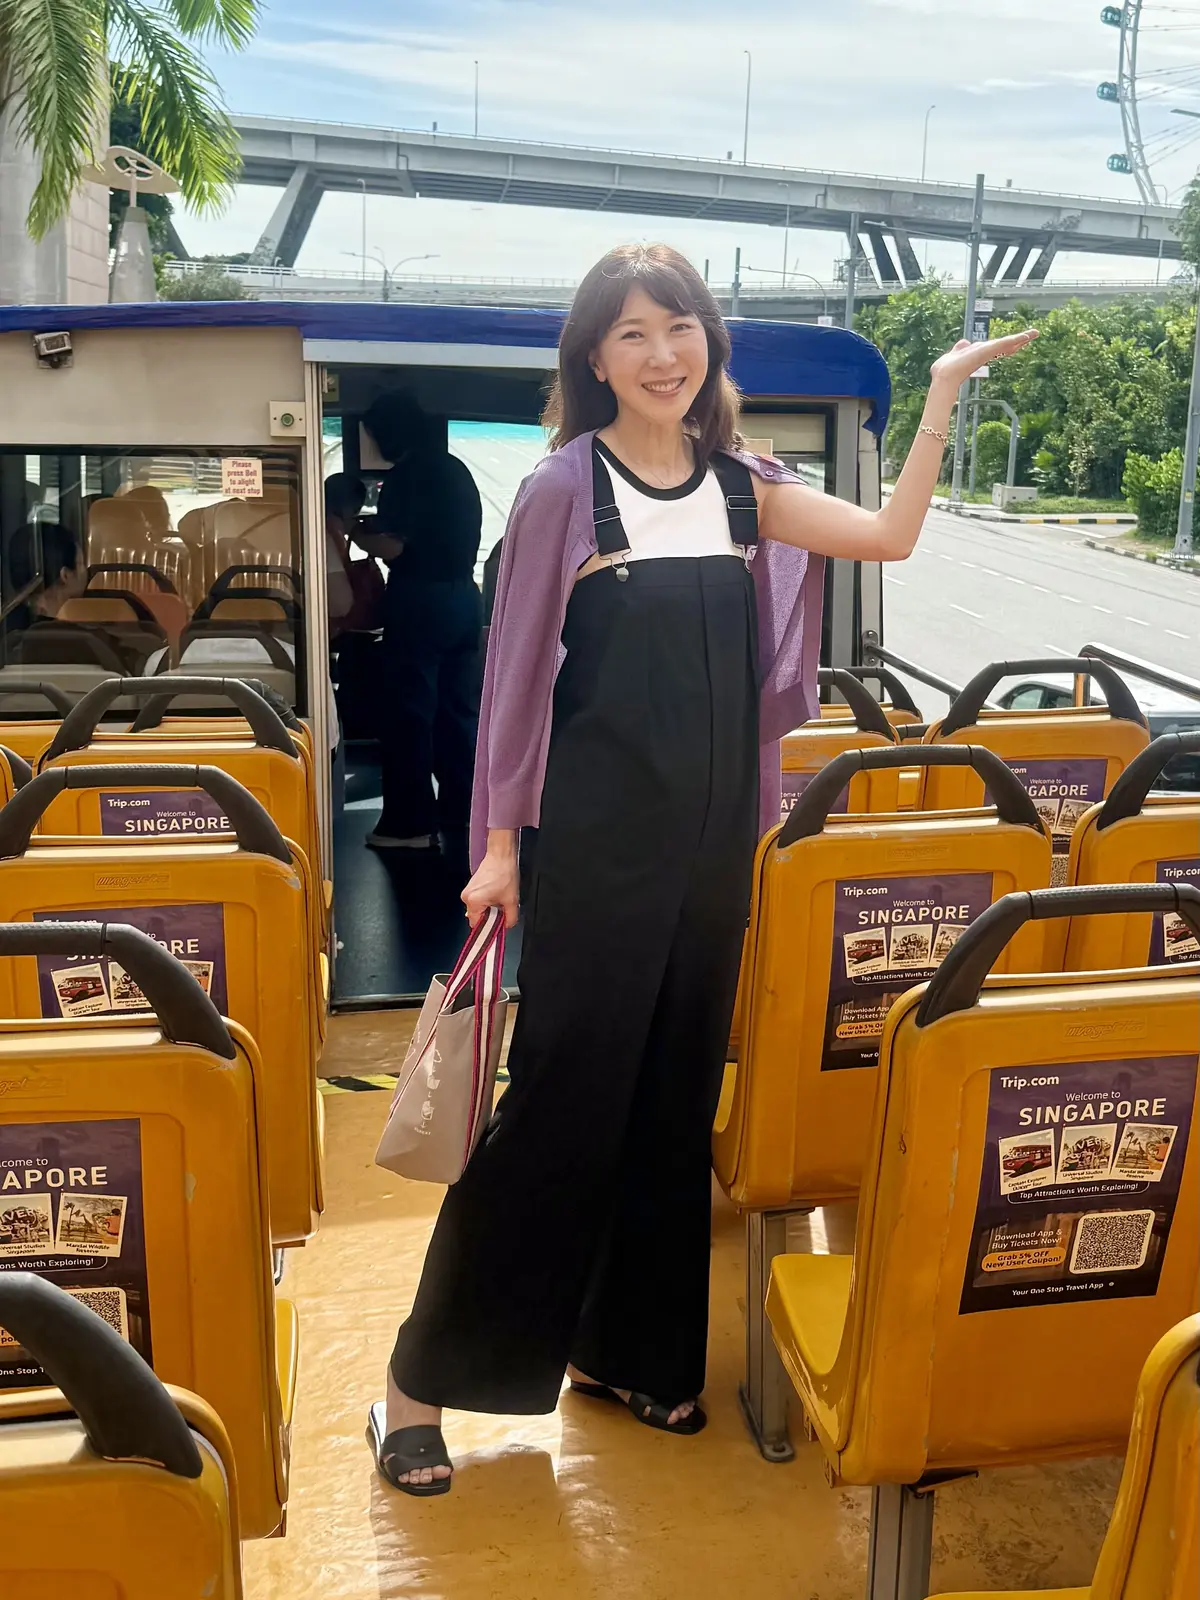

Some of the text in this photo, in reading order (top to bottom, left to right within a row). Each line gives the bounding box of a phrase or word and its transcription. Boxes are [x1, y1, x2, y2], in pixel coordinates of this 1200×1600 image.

[231, 460, 252, 468] Please
[238, 478, 255, 486] alight
[1024, 785, 1088, 796] GAPORE
[108, 799, 150, 808] Trip.com
[125, 816, 230, 832] SINGAPORE
[843, 886, 888, 897] Trip.com
[858, 905, 970, 924] SINGAPORE
[1000, 1076, 1060, 1090] Trip.com
[1066, 1091, 1121, 1102] Welcome to
[1019, 1098, 1166, 1126] SINGAPORE
[36, 1158, 48, 1166] to
[2, 1166, 107, 1190] APORE
[1034, 1189, 1075, 1197] Attractions
[1101, 1183, 1139, 1191] Exploring!
[995, 1231, 1036, 1241] Download
[1037, 1229, 1054, 1237] App
[18, 1261, 46, 1269] Worth
[49, 1258, 94, 1268] Exploring!
[1027, 1256, 1062, 1264] Coupon!
